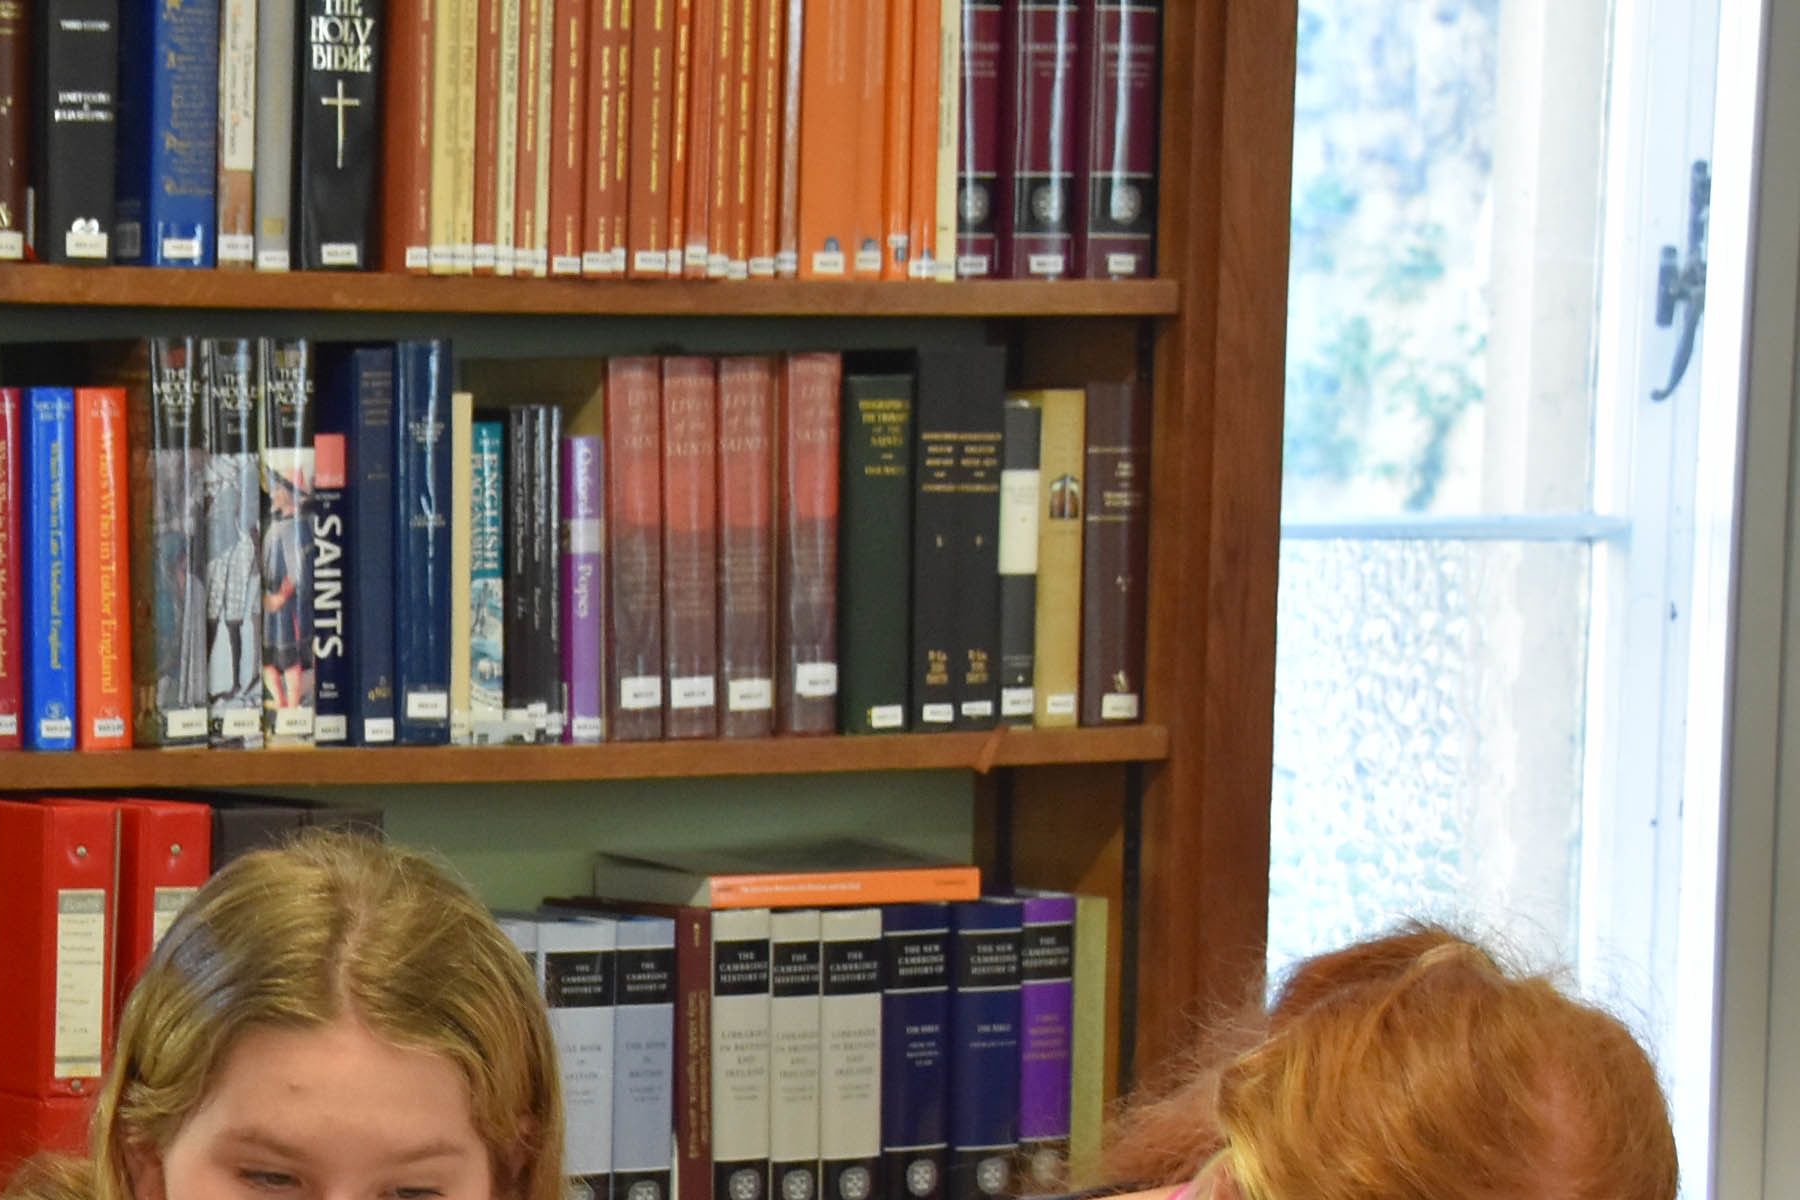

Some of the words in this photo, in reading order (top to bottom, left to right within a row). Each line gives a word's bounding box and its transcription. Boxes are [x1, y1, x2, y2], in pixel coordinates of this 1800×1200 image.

[310, 15, 374, 42] HOLY
[311, 45, 373, 72] BIBLE
[483, 453, 498, 569] ENGLISH
[101, 561, 117, 616] Tudor
[313, 514, 343, 659] SAINTS
[98, 617, 117, 694] England
[904, 945, 921, 953] THE
[923, 943, 940, 953] NEW
[977, 944, 993, 953] THE
[995, 943, 1013, 952] NEW
[738, 952, 755, 960] THE
[791, 953, 808, 962] THE
[847, 952, 864, 960] THE
[898, 954, 944, 965] CAMBRIDGE
[970, 954, 1017, 964] CAMBRIDGE
[719, 962, 769, 972] CAMBRIDGE
[773, 964, 820, 973] CAMBRIDGE
[829, 962, 878, 971] CAMBRIDGE
[899, 966, 933, 976] HISTORY
[971, 965, 1006, 975] HISTORY
[561, 974, 603, 983] CAMBRIDGE
[626, 972, 668, 981] CAMBRIDGE
[720, 973, 757, 983] HISTORY
[774, 975, 808, 984] HISTORY
[830, 973, 866, 982] HISTORY
[626, 984, 656, 992] HISTORY
